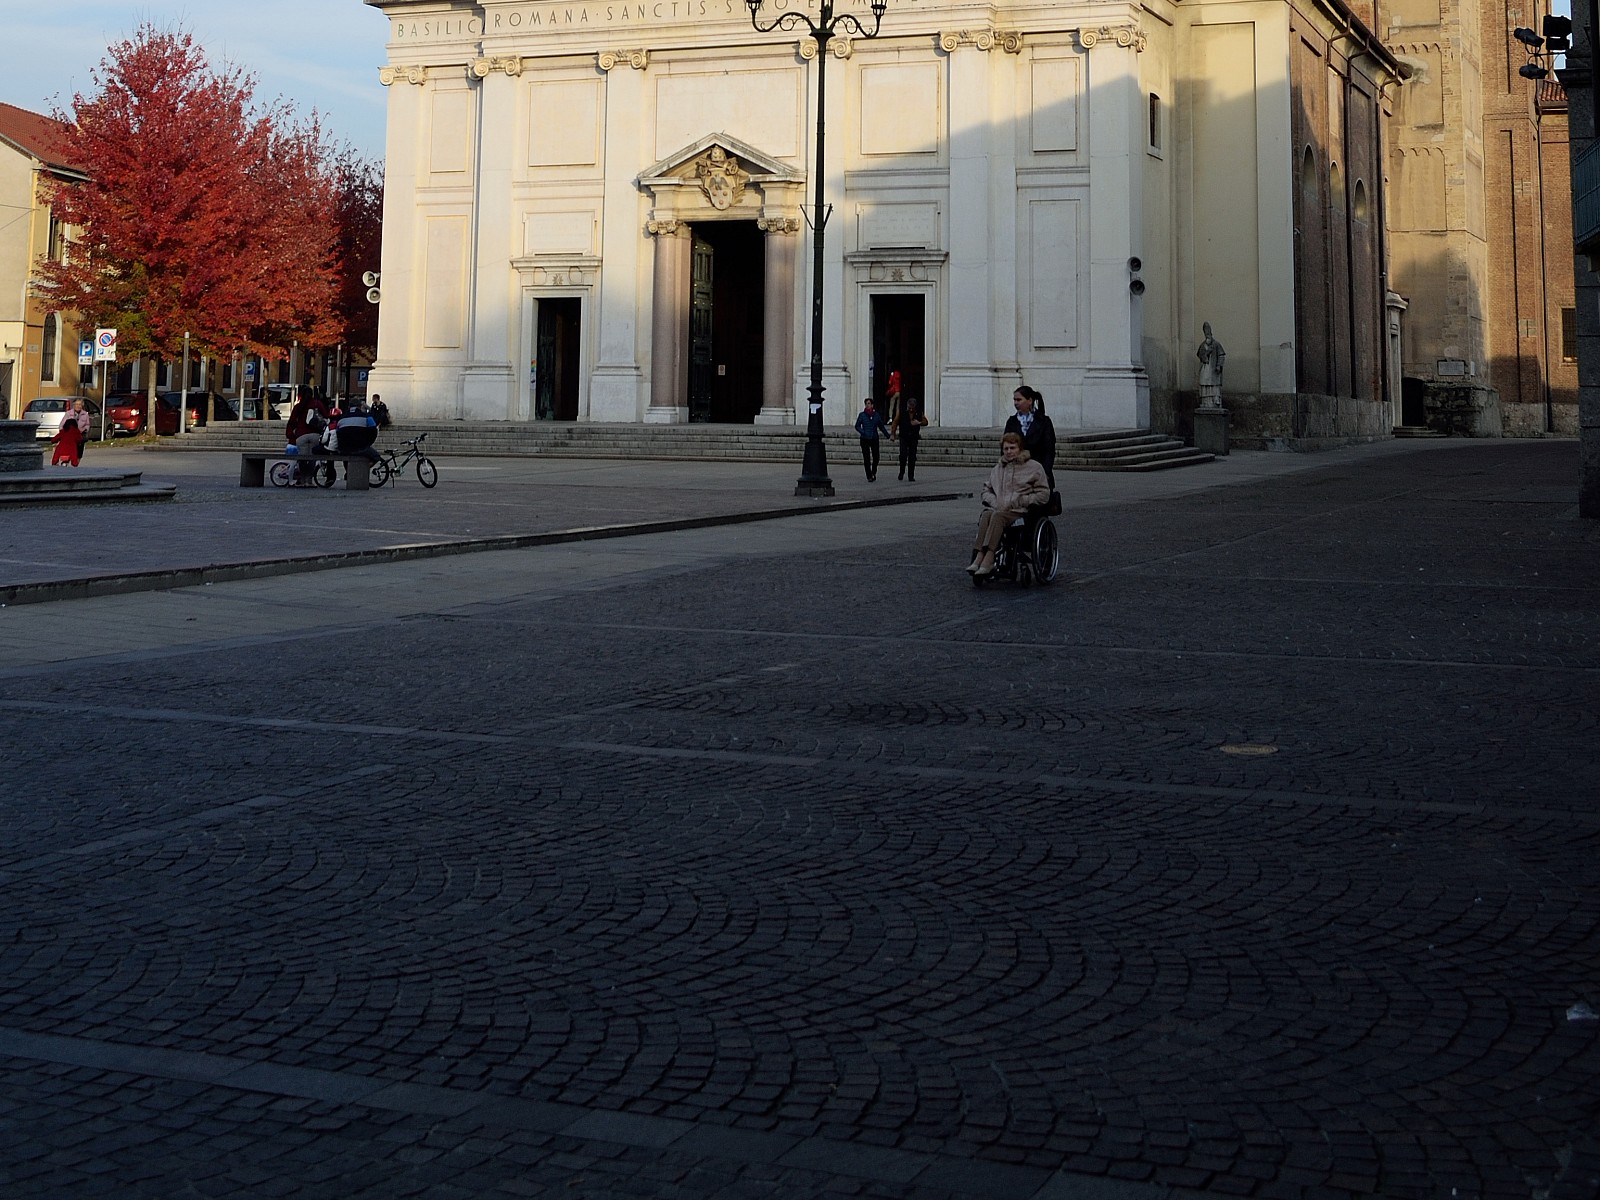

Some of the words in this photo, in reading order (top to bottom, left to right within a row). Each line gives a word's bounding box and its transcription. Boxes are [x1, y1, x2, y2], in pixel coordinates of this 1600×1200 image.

[398, 18, 477, 38] BASILIC
[494, 8, 589, 28] ROMANA
[606, 0, 706, 21] SANCTIS
[81, 342, 92, 356] P
[245, 363, 254, 374] P
[360, 371, 367, 381] P
